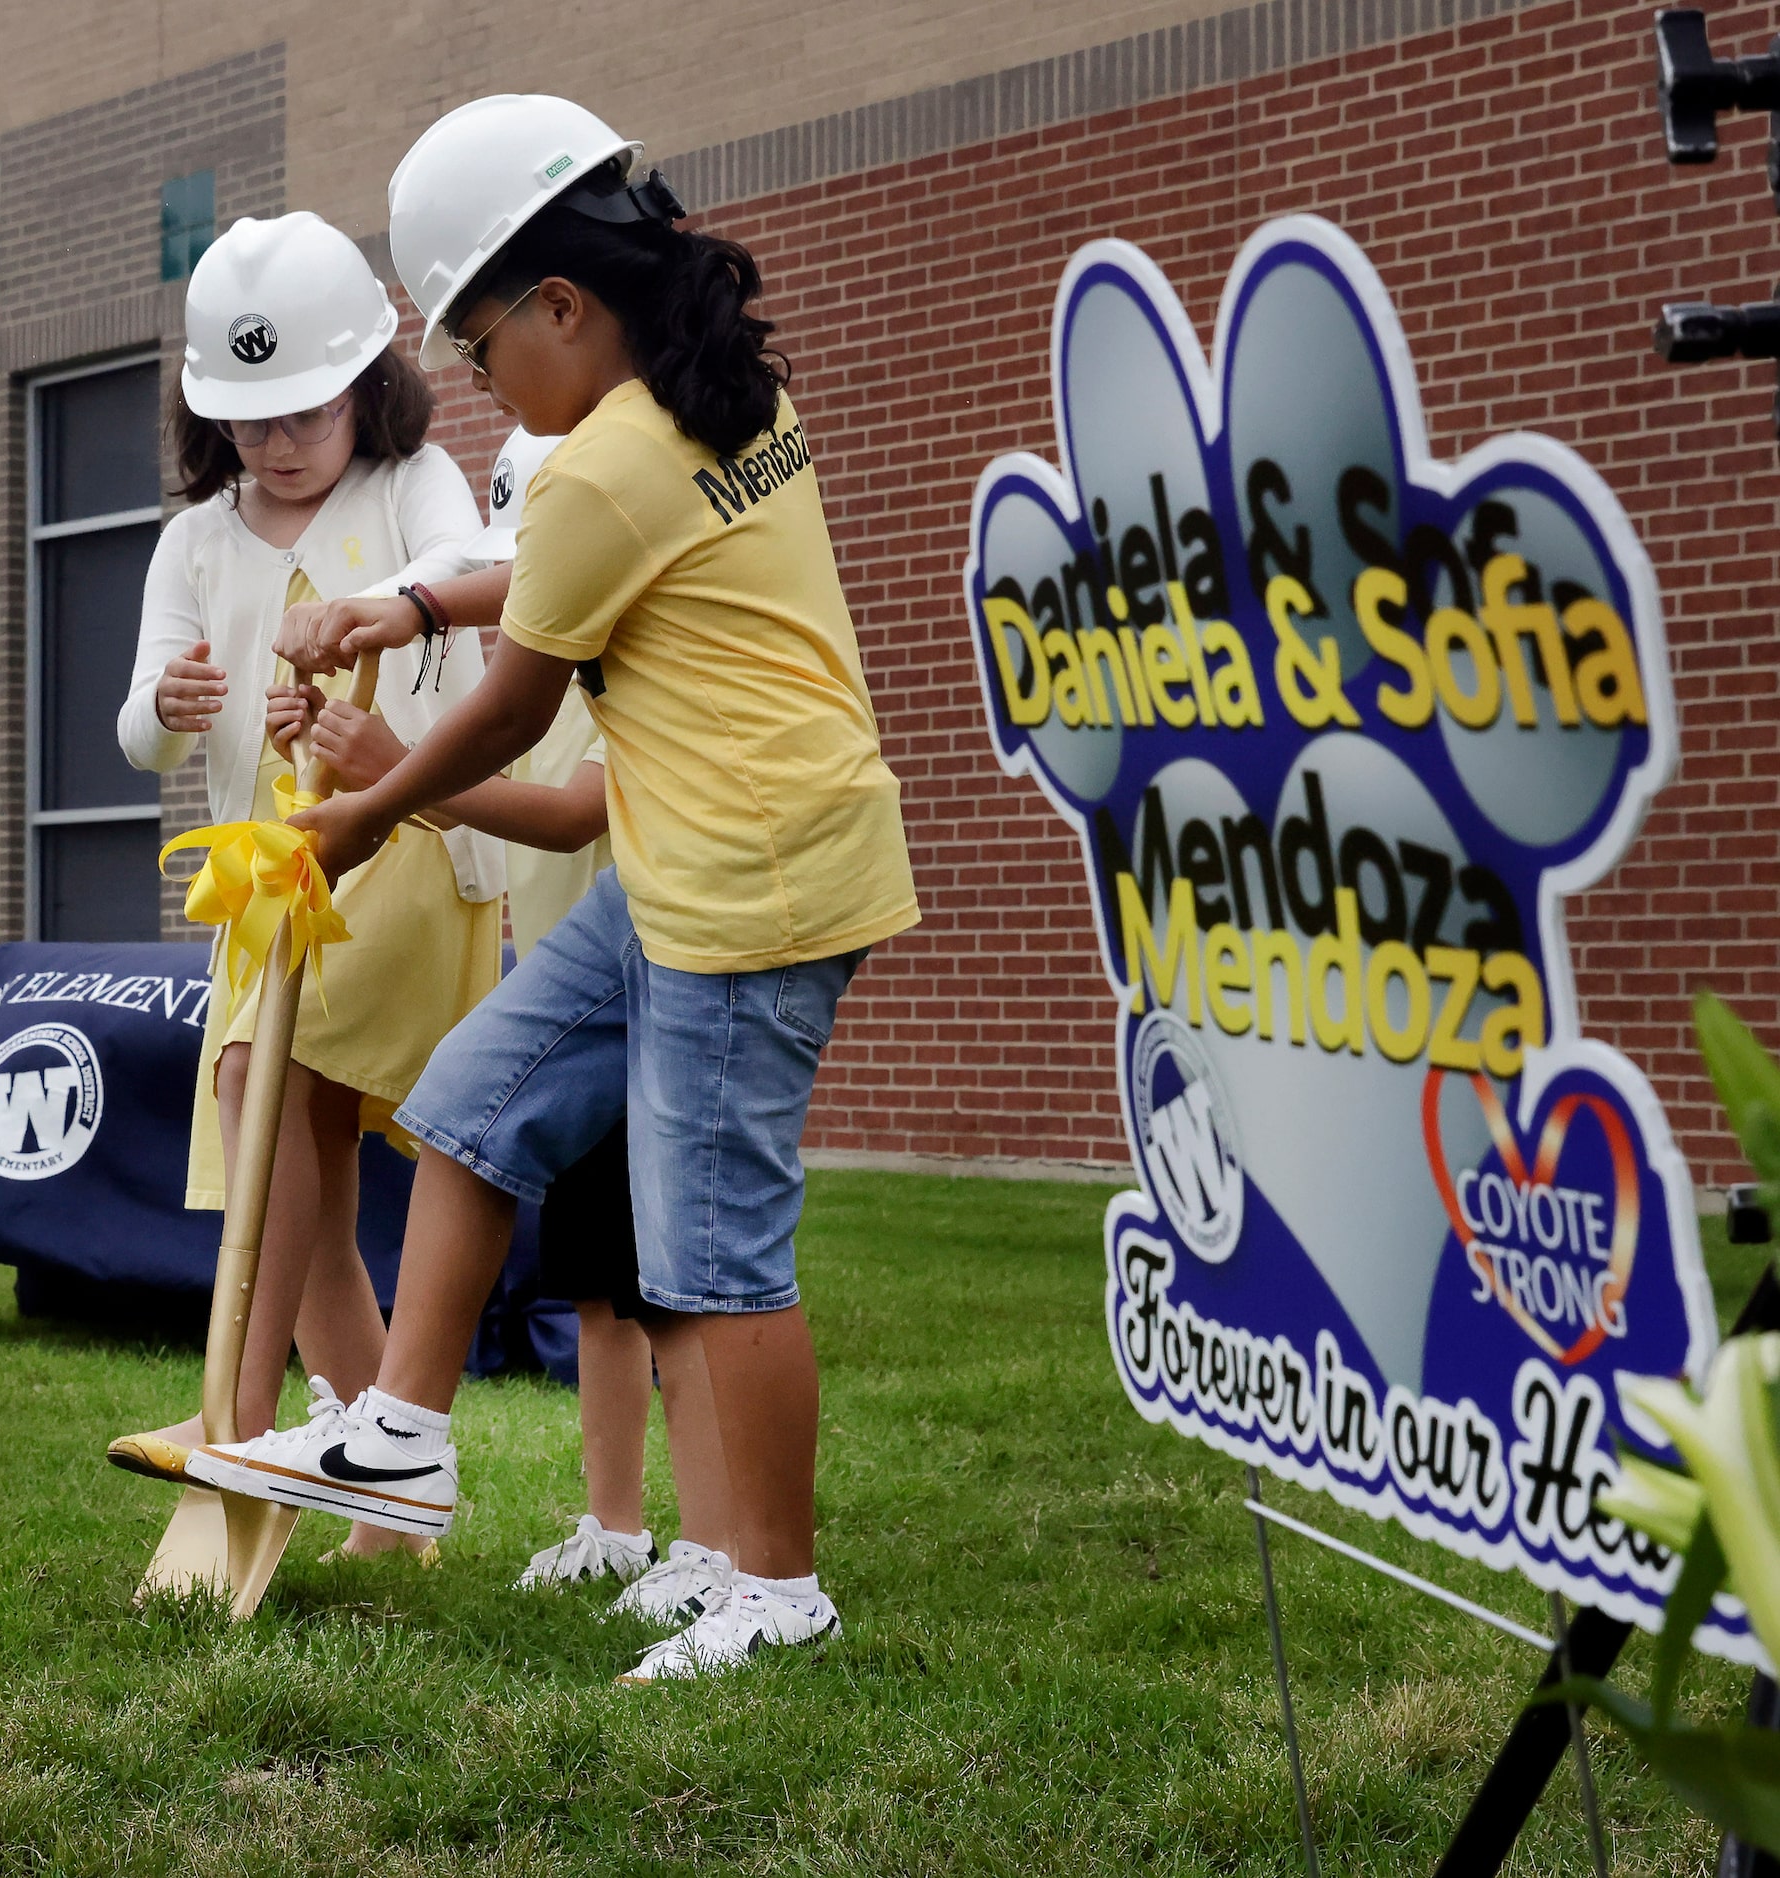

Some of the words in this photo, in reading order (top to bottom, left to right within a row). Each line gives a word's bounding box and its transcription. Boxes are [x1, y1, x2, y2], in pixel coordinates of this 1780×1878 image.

[547, 157, 573, 178] MSA
[984, 580, 1266, 727] Daniela
[1266, 574, 1362, 728] &
[1353, 553, 1648, 728] Sofia
[7, 971, 211, 1029] ELEMENT
[1115, 871, 1546, 1078] Mendoza
[1456, 1167, 1610, 1262] COYOTE
[1466, 1238, 1628, 1339] STRONG
[1125, 1244, 1311, 1436] Forever
[1325, 1348, 1376, 1461] in
[1393, 1403, 1501, 1509] our
